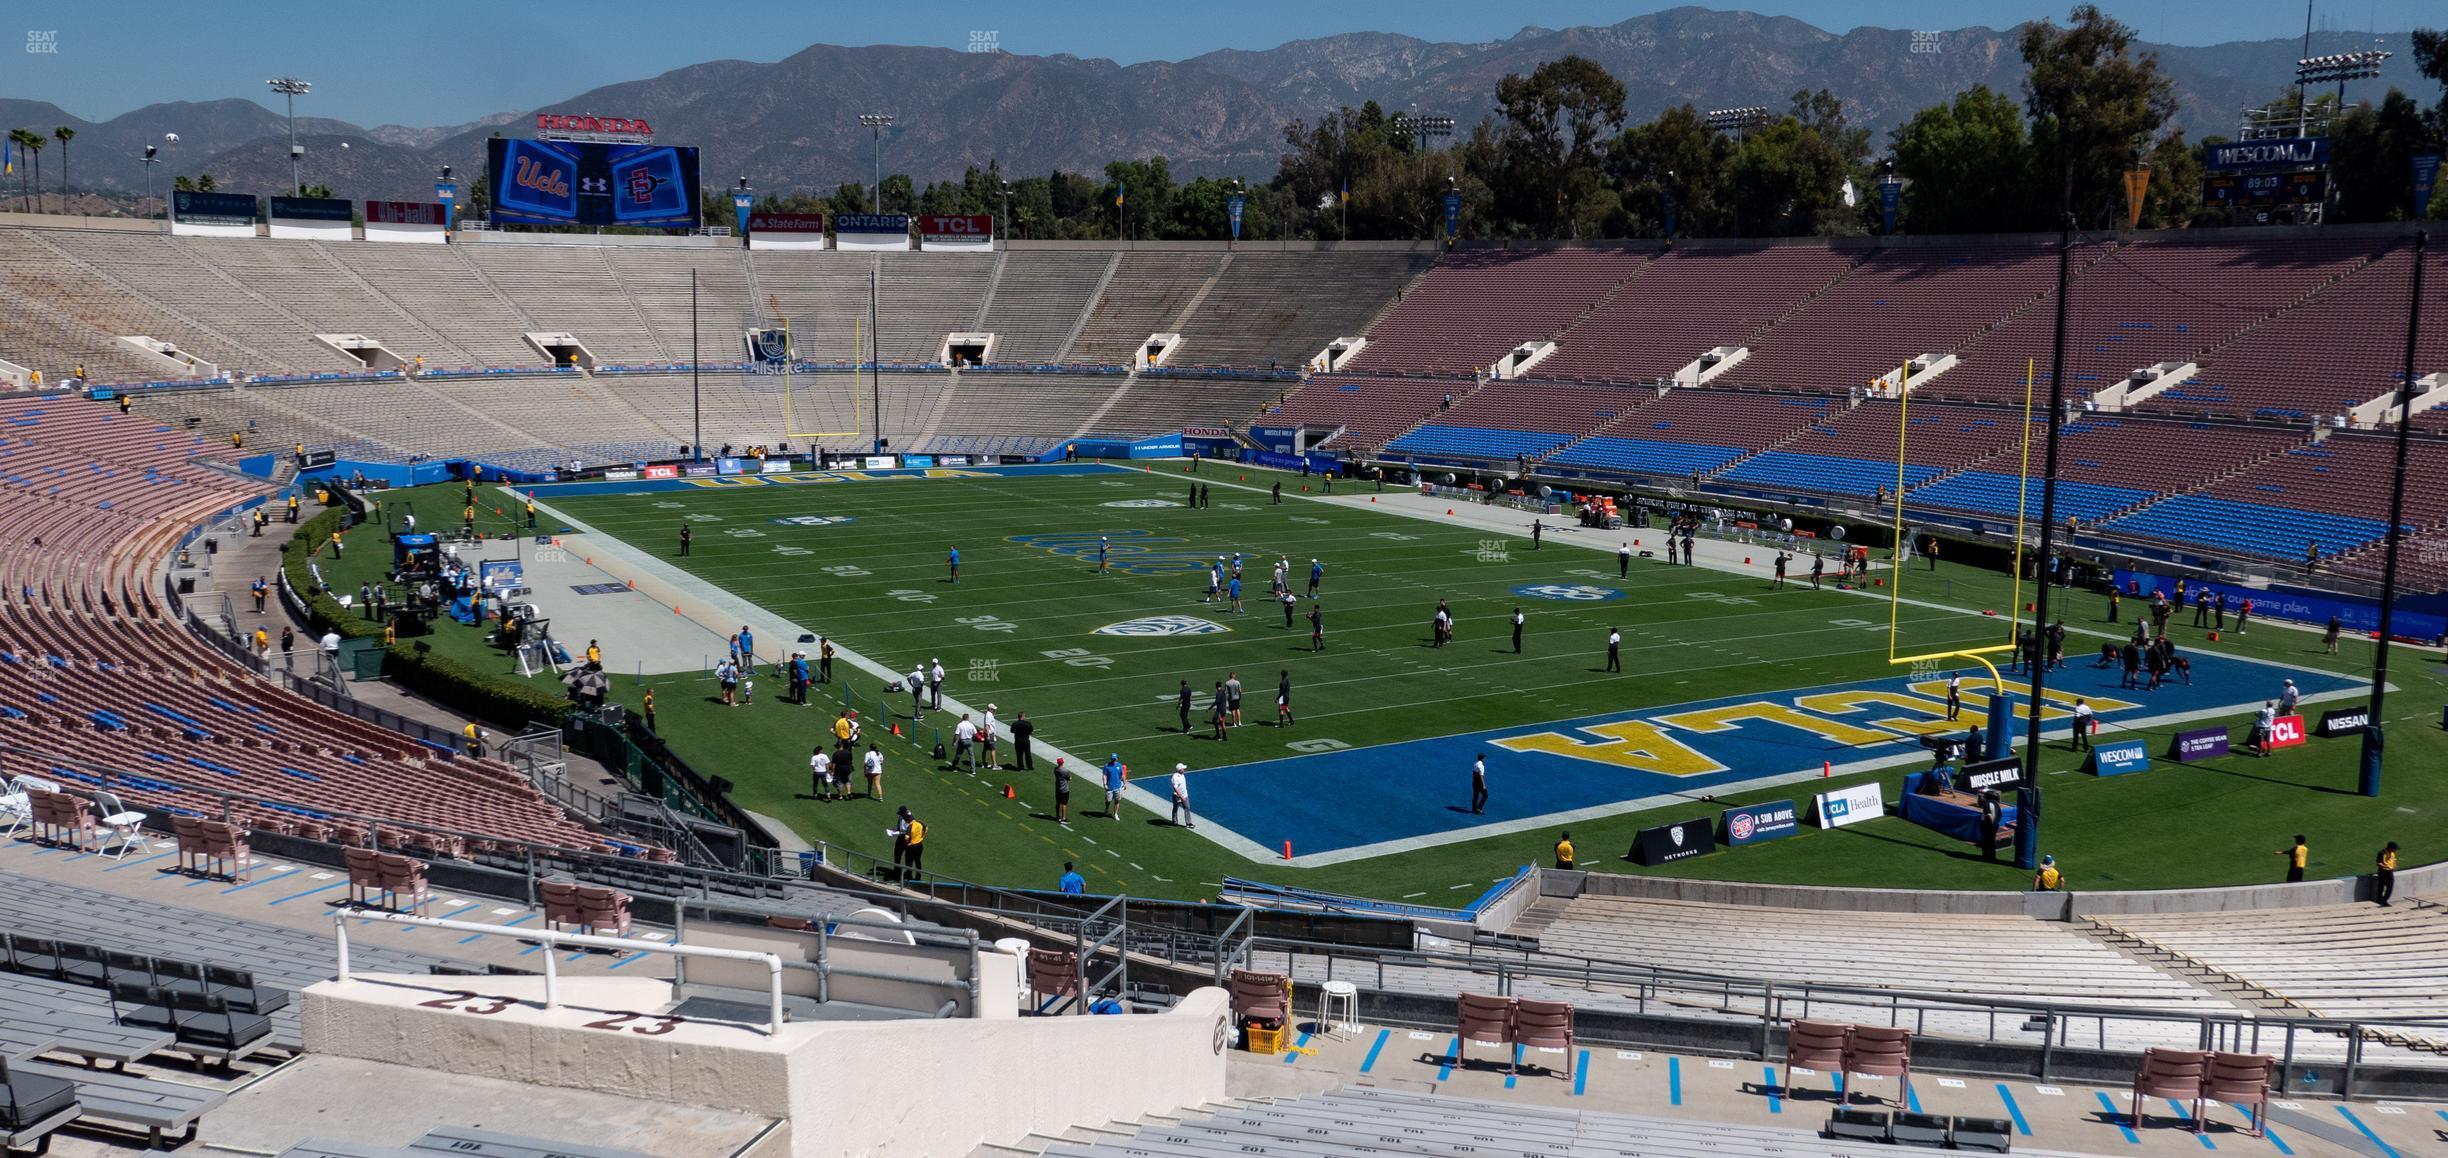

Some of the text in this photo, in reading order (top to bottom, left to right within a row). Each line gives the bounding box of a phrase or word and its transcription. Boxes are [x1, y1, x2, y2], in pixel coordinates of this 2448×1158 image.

[537, 114, 655, 134] HONDA
[2216, 144, 2293, 165] WESCOM
[517, 156, 570, 198] Ucla
[2247, 175, 2278, 188] 89:03
[934, 218, 980, 232] TCL
[750, 361, 803, 375] Allstate
[1183, 428, 1228, 437] HONDA
[649, 468, 673, 476] TCL
[680, 469, 1004, 487] UCLA
[1666, 501, 1687, 511] FIELD
[1688, 504, 1698, 512] AT
[953, 615, 1020, 631] 30
[1038, 648, 1117, 668] 20
[1485, 676, 2145, 779] UCLA
[2327, 713, 2368, 731] NISSAN
[2099, 749, 2134, 764] WESCOM
[1970, 768, 2020, 789] MUSCLE MILK
[1825, 795, 1879, 815] UCLA Health
[1755, 815, 1760, 825] A
[1761, 812, 1773, 824] SUB
[1664, 849, 1698, 860] NETWORKS
[418, 991, 518, 1015] 23
[581, 1010, 686, 1035] 23
